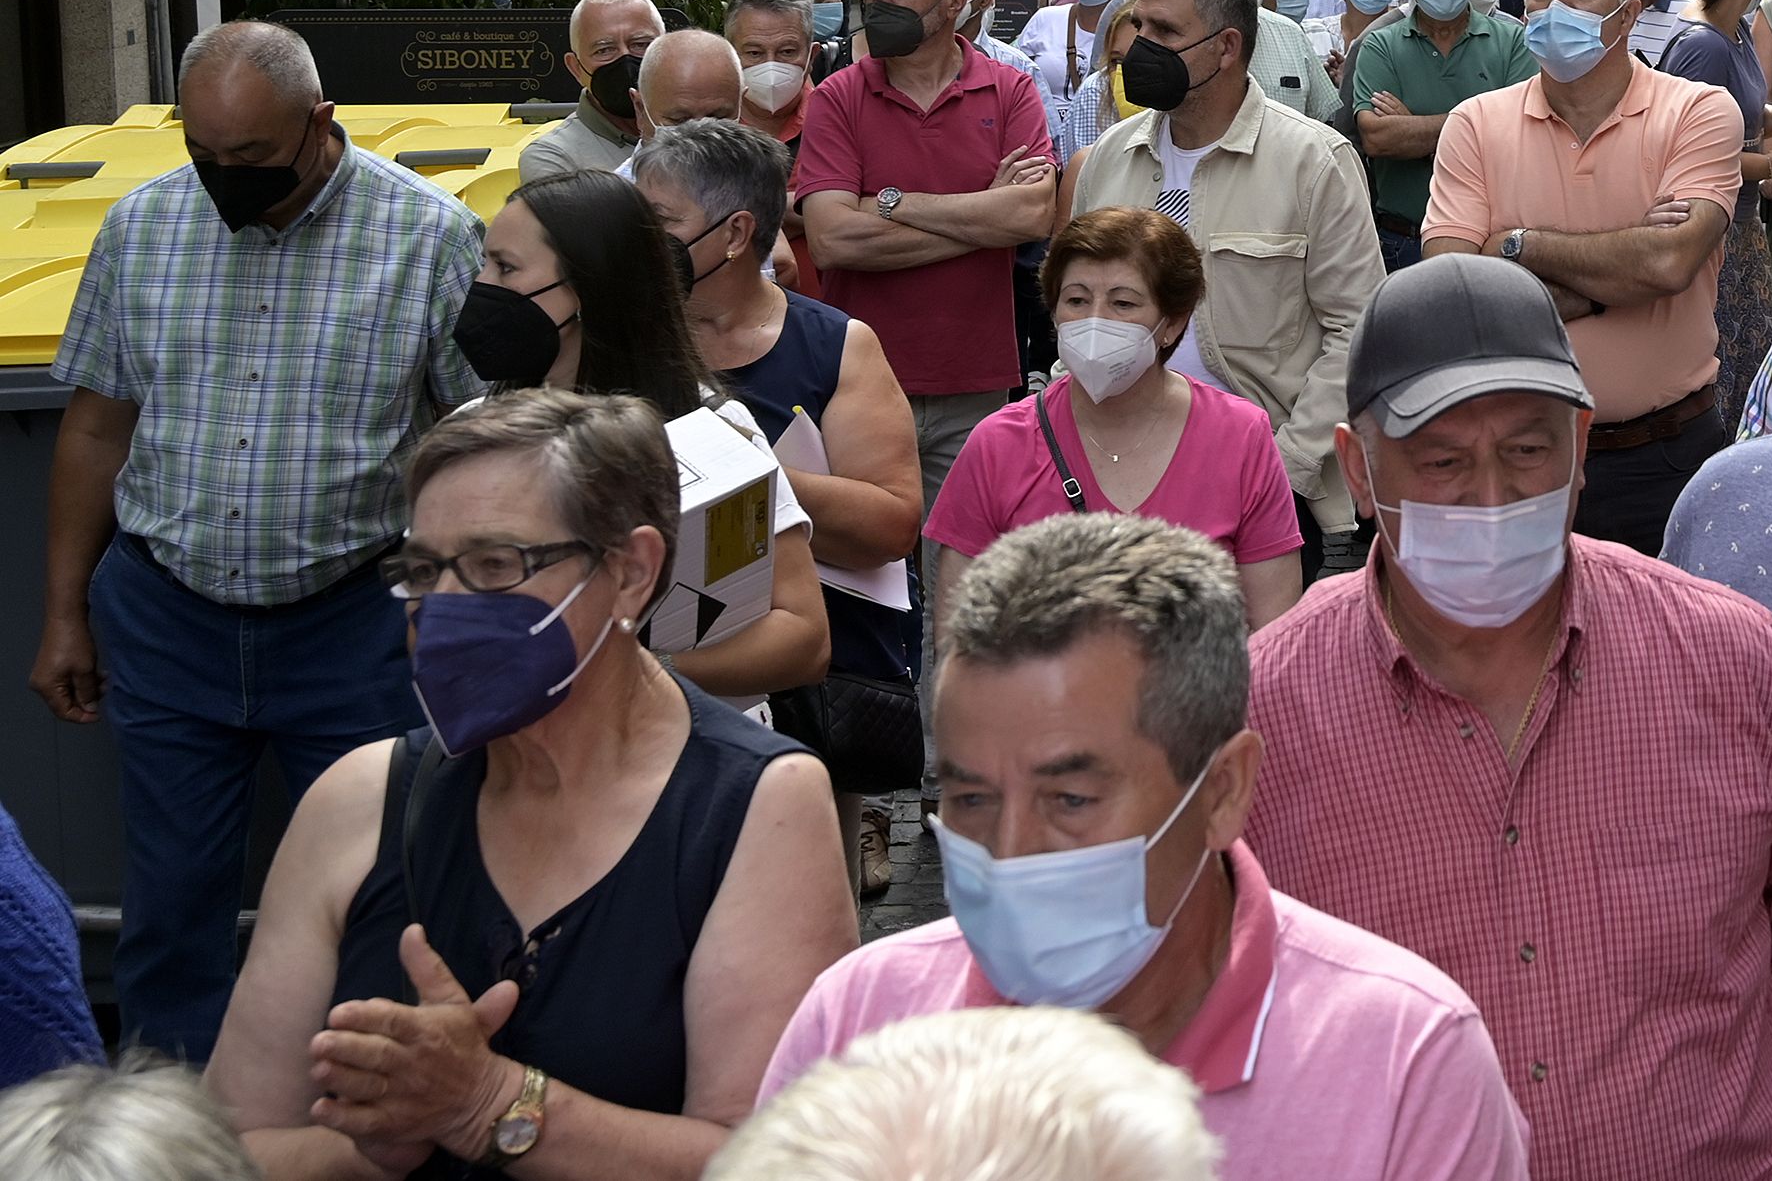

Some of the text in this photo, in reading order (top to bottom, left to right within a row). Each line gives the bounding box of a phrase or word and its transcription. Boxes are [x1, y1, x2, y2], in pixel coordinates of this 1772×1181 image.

[440, 31, 515, 42] café & boutique
[417, 49, 535, 70] SIBONEY
